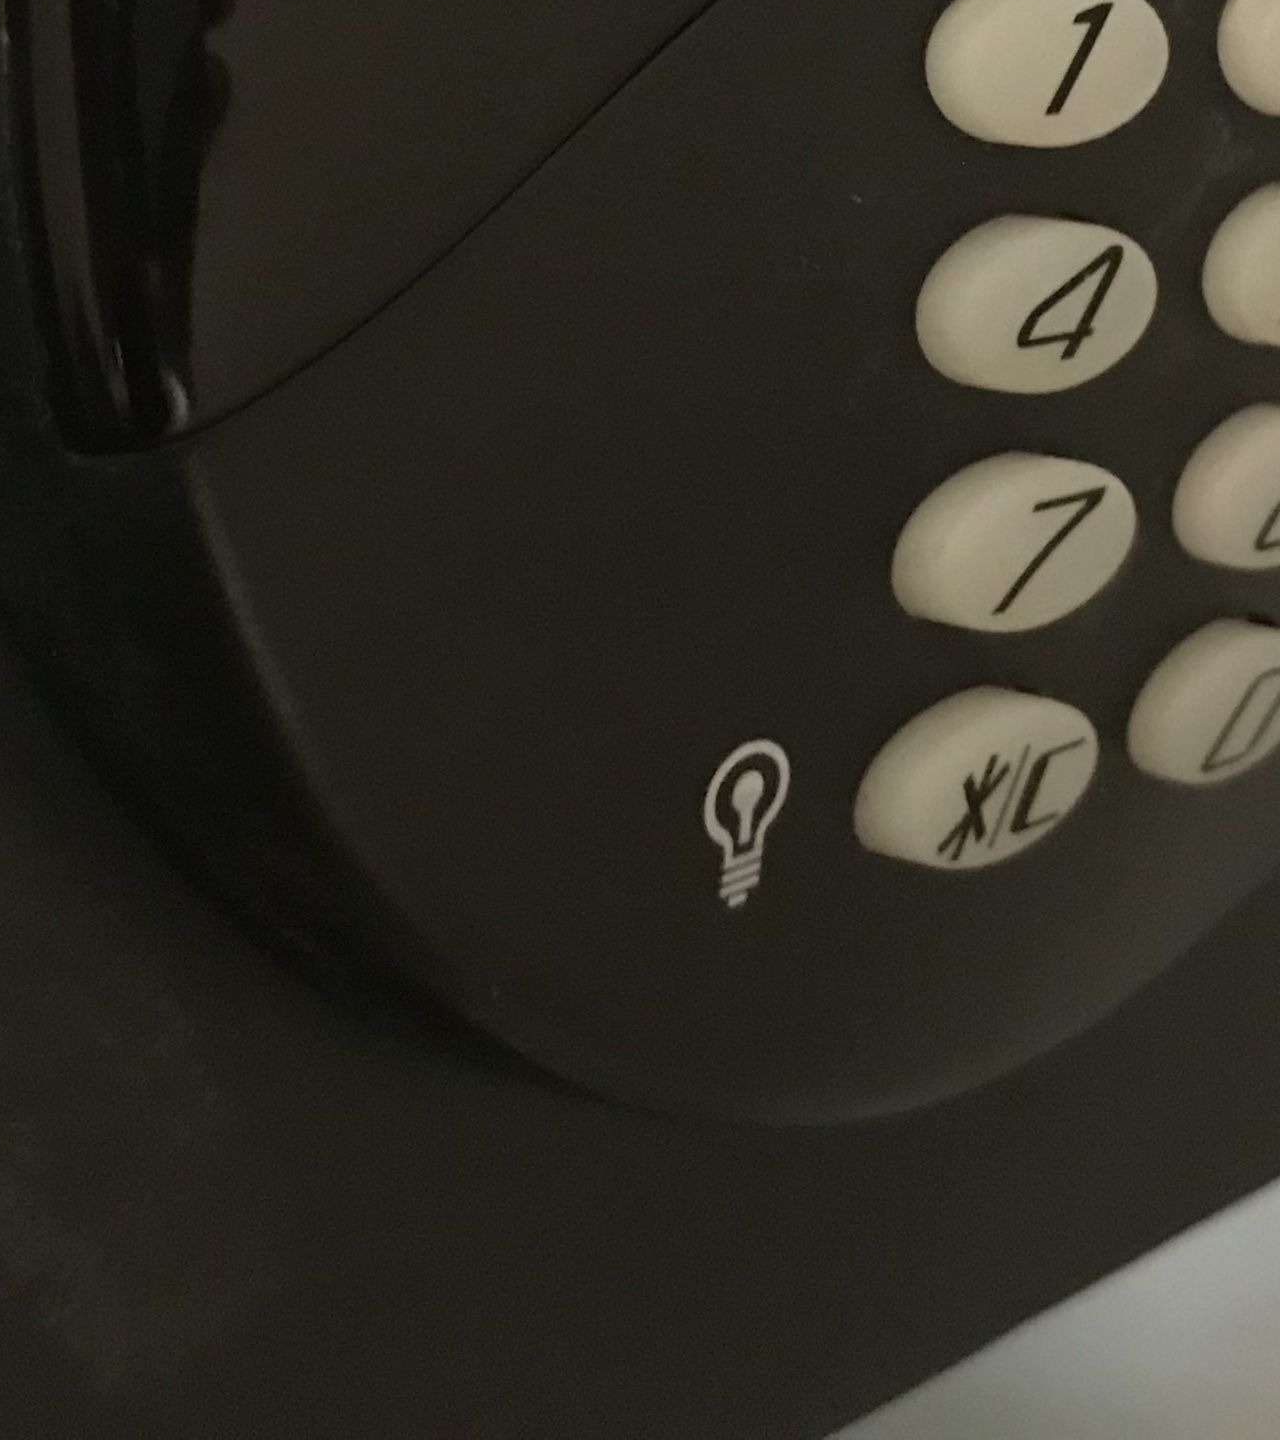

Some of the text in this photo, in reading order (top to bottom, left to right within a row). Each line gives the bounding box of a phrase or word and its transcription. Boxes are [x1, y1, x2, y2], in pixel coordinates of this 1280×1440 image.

[1044, 1, 1115, 117] 1
[1016, 243, 1125, 361] 4
[991, 485, 1107, 617] 7
